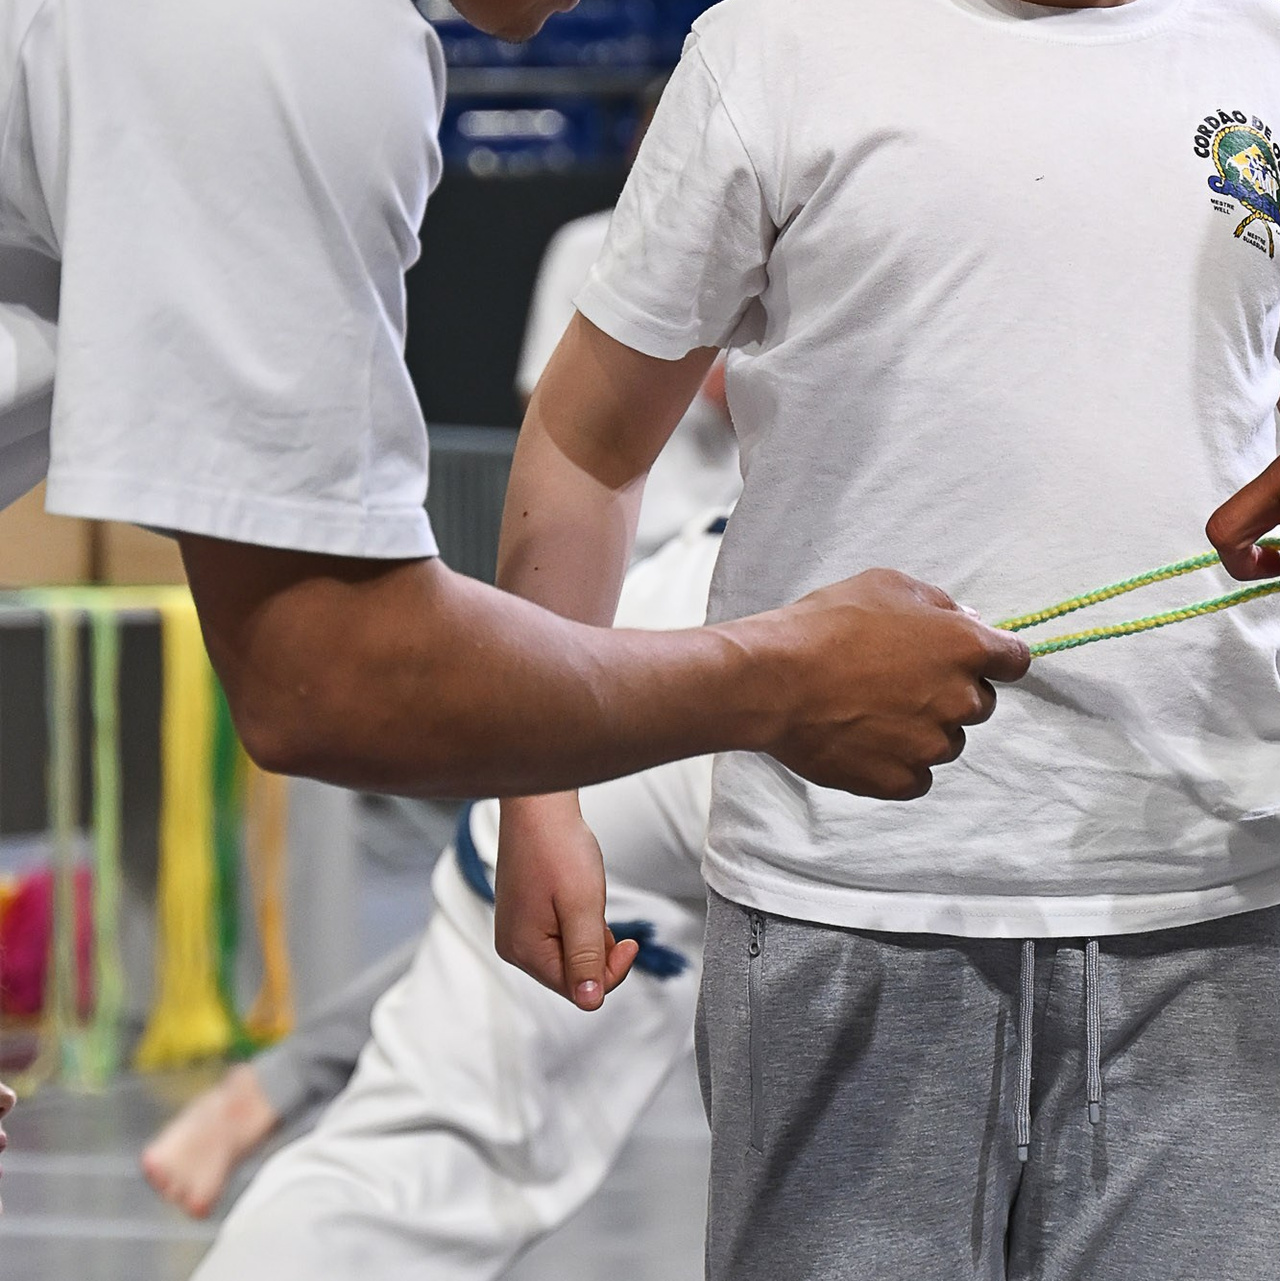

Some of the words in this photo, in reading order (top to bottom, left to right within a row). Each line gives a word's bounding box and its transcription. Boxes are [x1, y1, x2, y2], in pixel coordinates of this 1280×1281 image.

[1193, 108, 1248, 159] CORDÃO
[1251, 114, 1273, 142] DE
[1210, 198, 1236, 211] MESTRE
[1213, 205, 1231, 216] WELL
